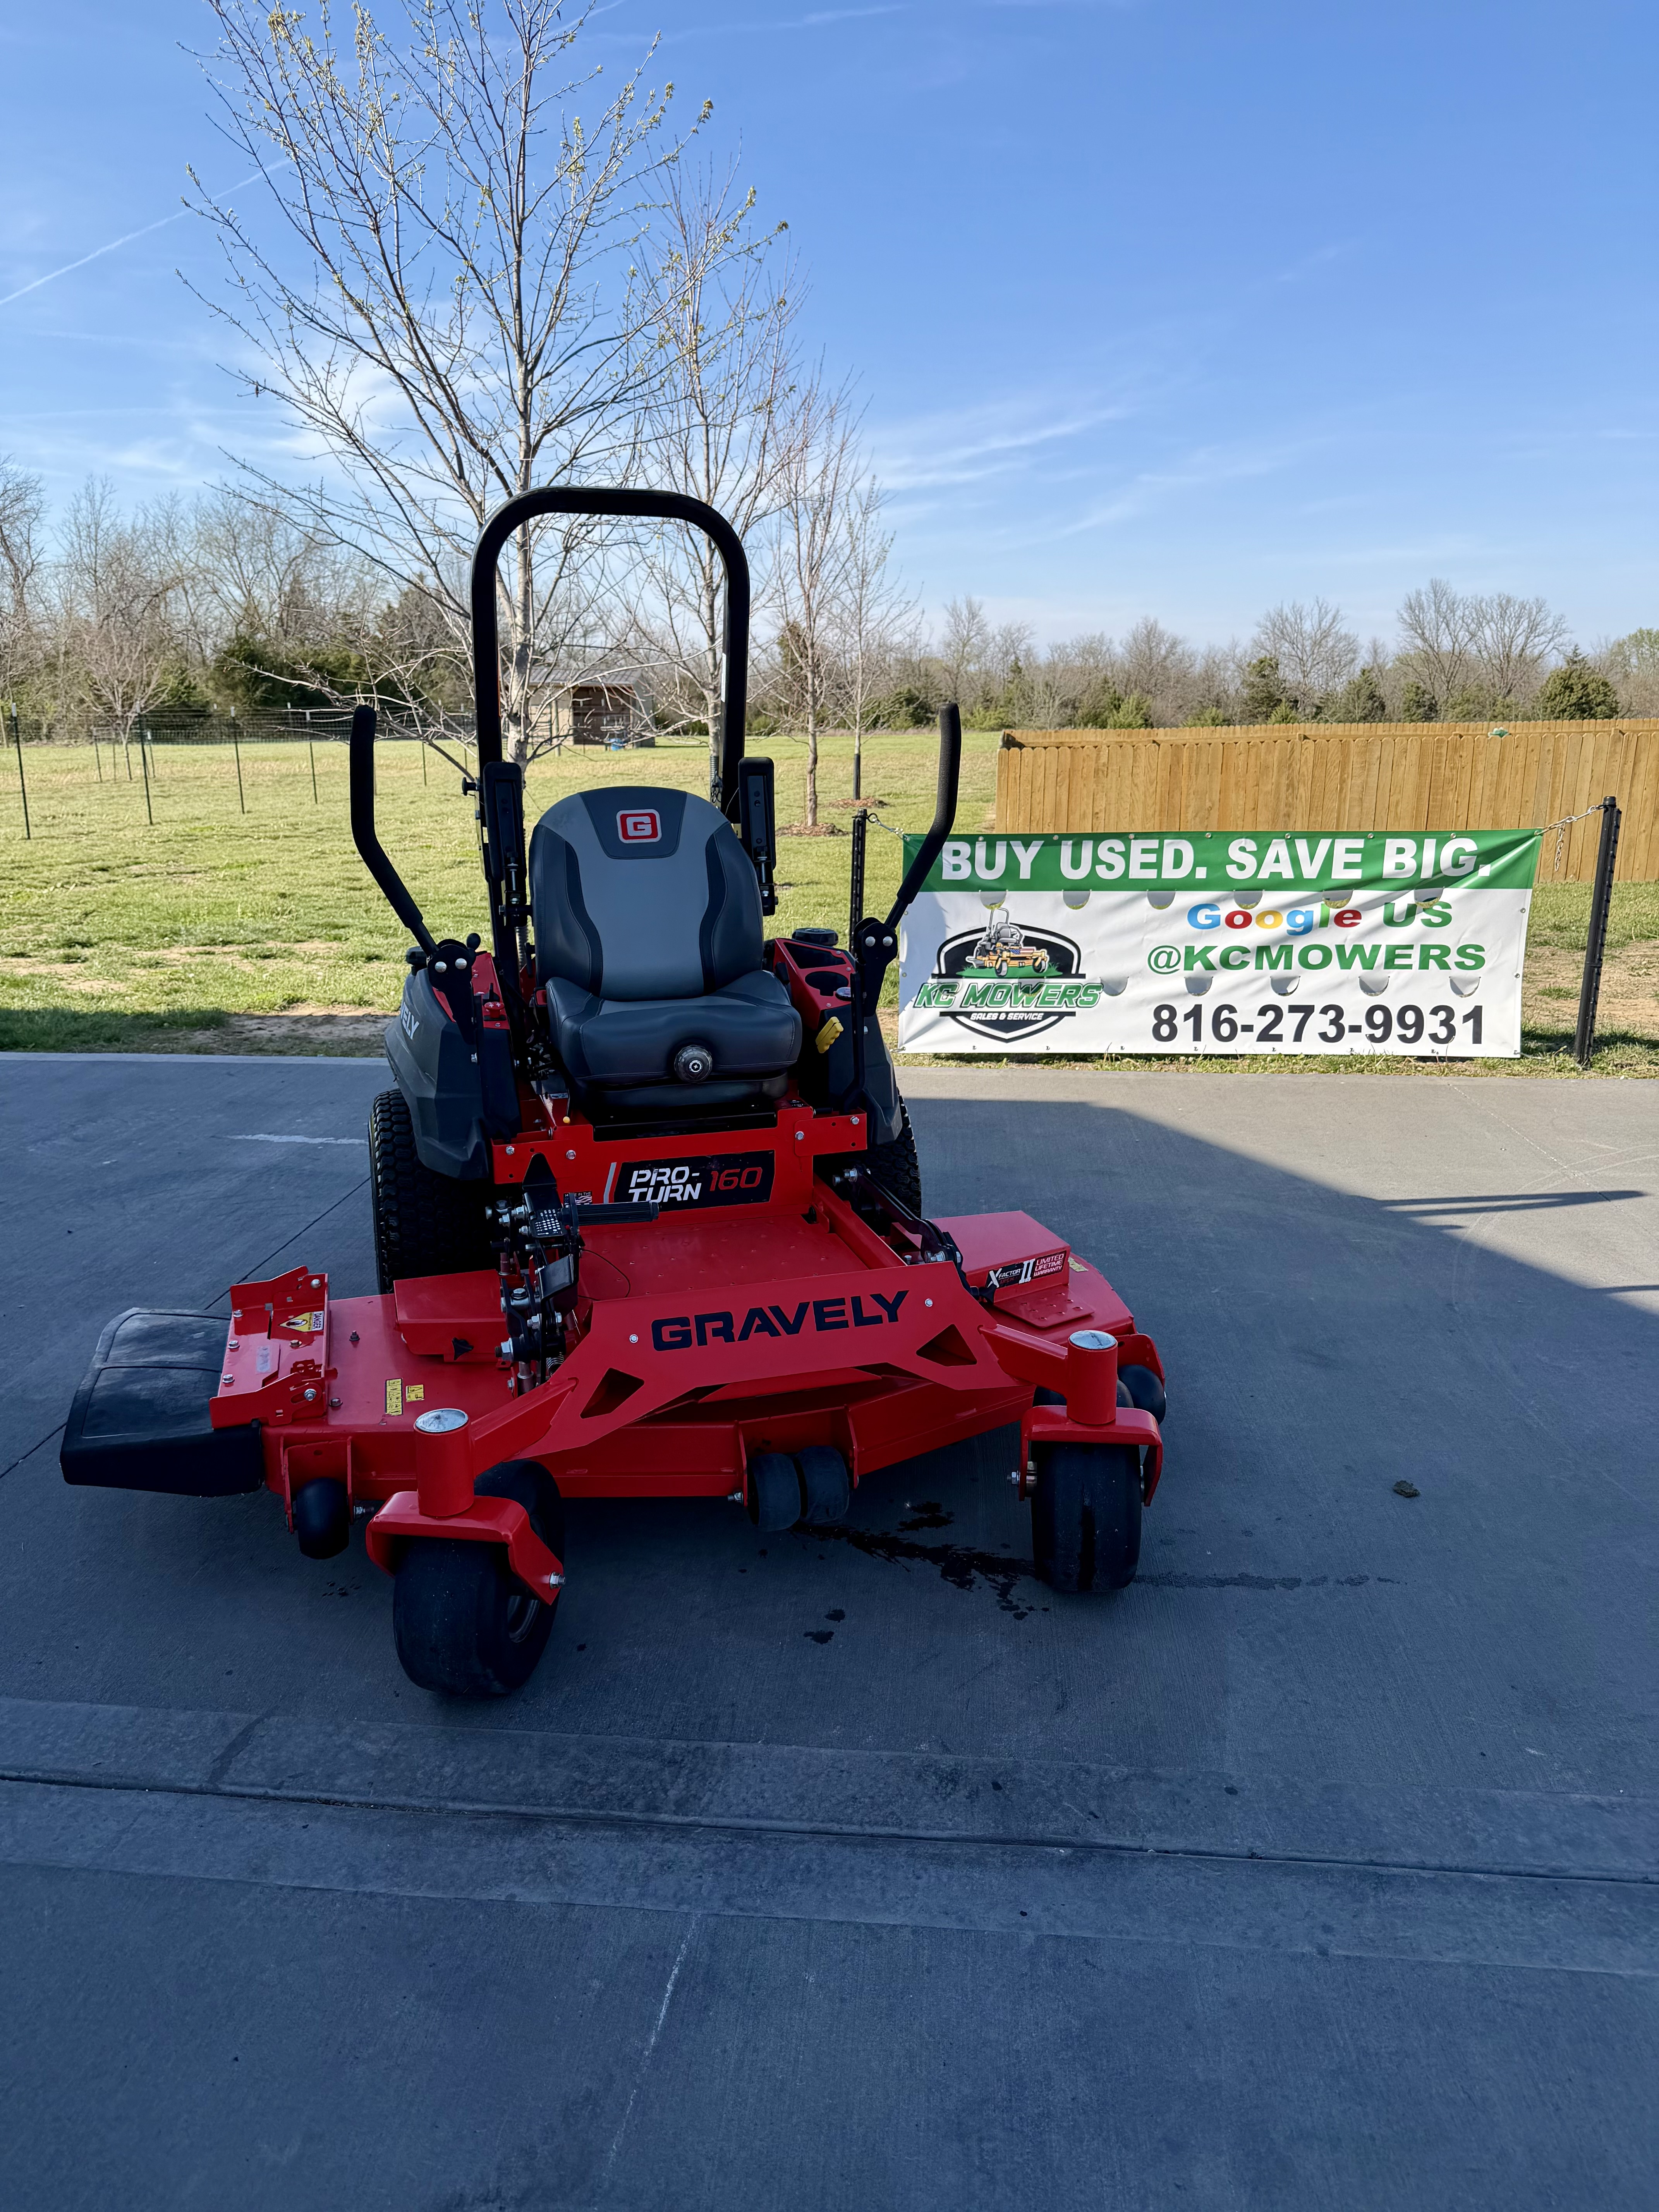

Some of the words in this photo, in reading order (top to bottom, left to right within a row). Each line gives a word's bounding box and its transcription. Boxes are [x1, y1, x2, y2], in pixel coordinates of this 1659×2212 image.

[626, 816, 652, 836] G
[941, 841, 1044, 880] BUY
[1060, 839, 1207, 879] USED.
[1225, 838, 1364, 879] SAVE
[1382, 838, 1491, 879] BIG.
[1187, 903, 1362, 936] Google
[1382, 901, 1453, 928] US
[1148, 944, 1486, 974] @KCMOWERS
[913, 982, 960, 1008] KC
[960, 982, 1104, 1008] MOWERS
[970, 1012, 998, 1020] SALES
[1007, 1012, 1044, 1020] SERVICE
[1152, 1003, 1485, 1045] 816-273-9931
[630, 1166, 700, 1187] PRO-
[710, 1167, 763, 1191] 160
[628, 1183, 702, 1203] TURN
[1035, 1259, 1063, 1271] LIFETIME
[1036, 1253, 1064, 1266] LIMITED
[998, 1268, 1021, 1279] FACTOR
[1033, 1265, 1062, 1277] WARRANTY
[313, 1313, 322, 1329] DANGER
[651, 1290, 909, 1352] GRAVELY
